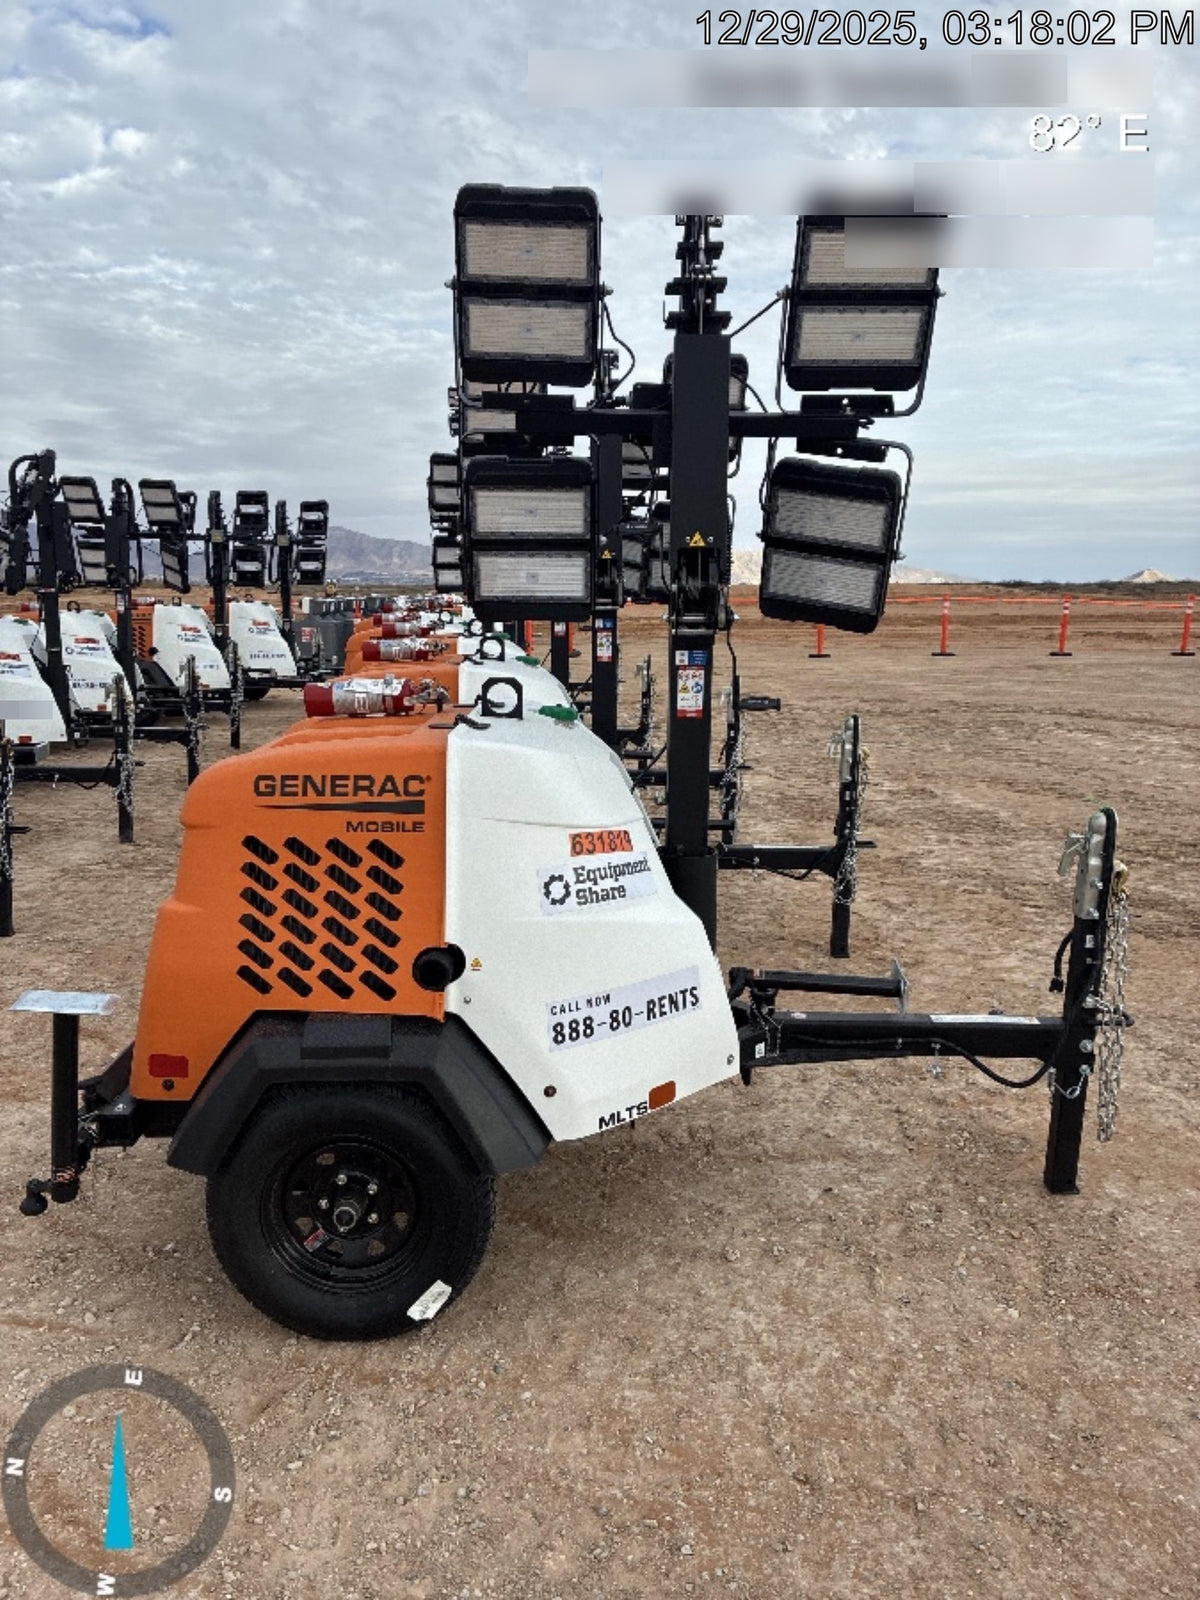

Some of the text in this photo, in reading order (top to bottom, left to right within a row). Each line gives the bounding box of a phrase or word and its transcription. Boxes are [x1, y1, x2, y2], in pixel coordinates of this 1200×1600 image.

[254, 774, 426, 797] GENERAC
[346, 820, 425, 833] MOBILE
[573, 856, 652, 886] Equipment
[575, 884, 627, 906] Share
[550, 993, 611, 1016] CALL NOW
[552, 986, 700, 1045] 888-80-RENTS
[598, 1100, 648, 1130] MLTS
